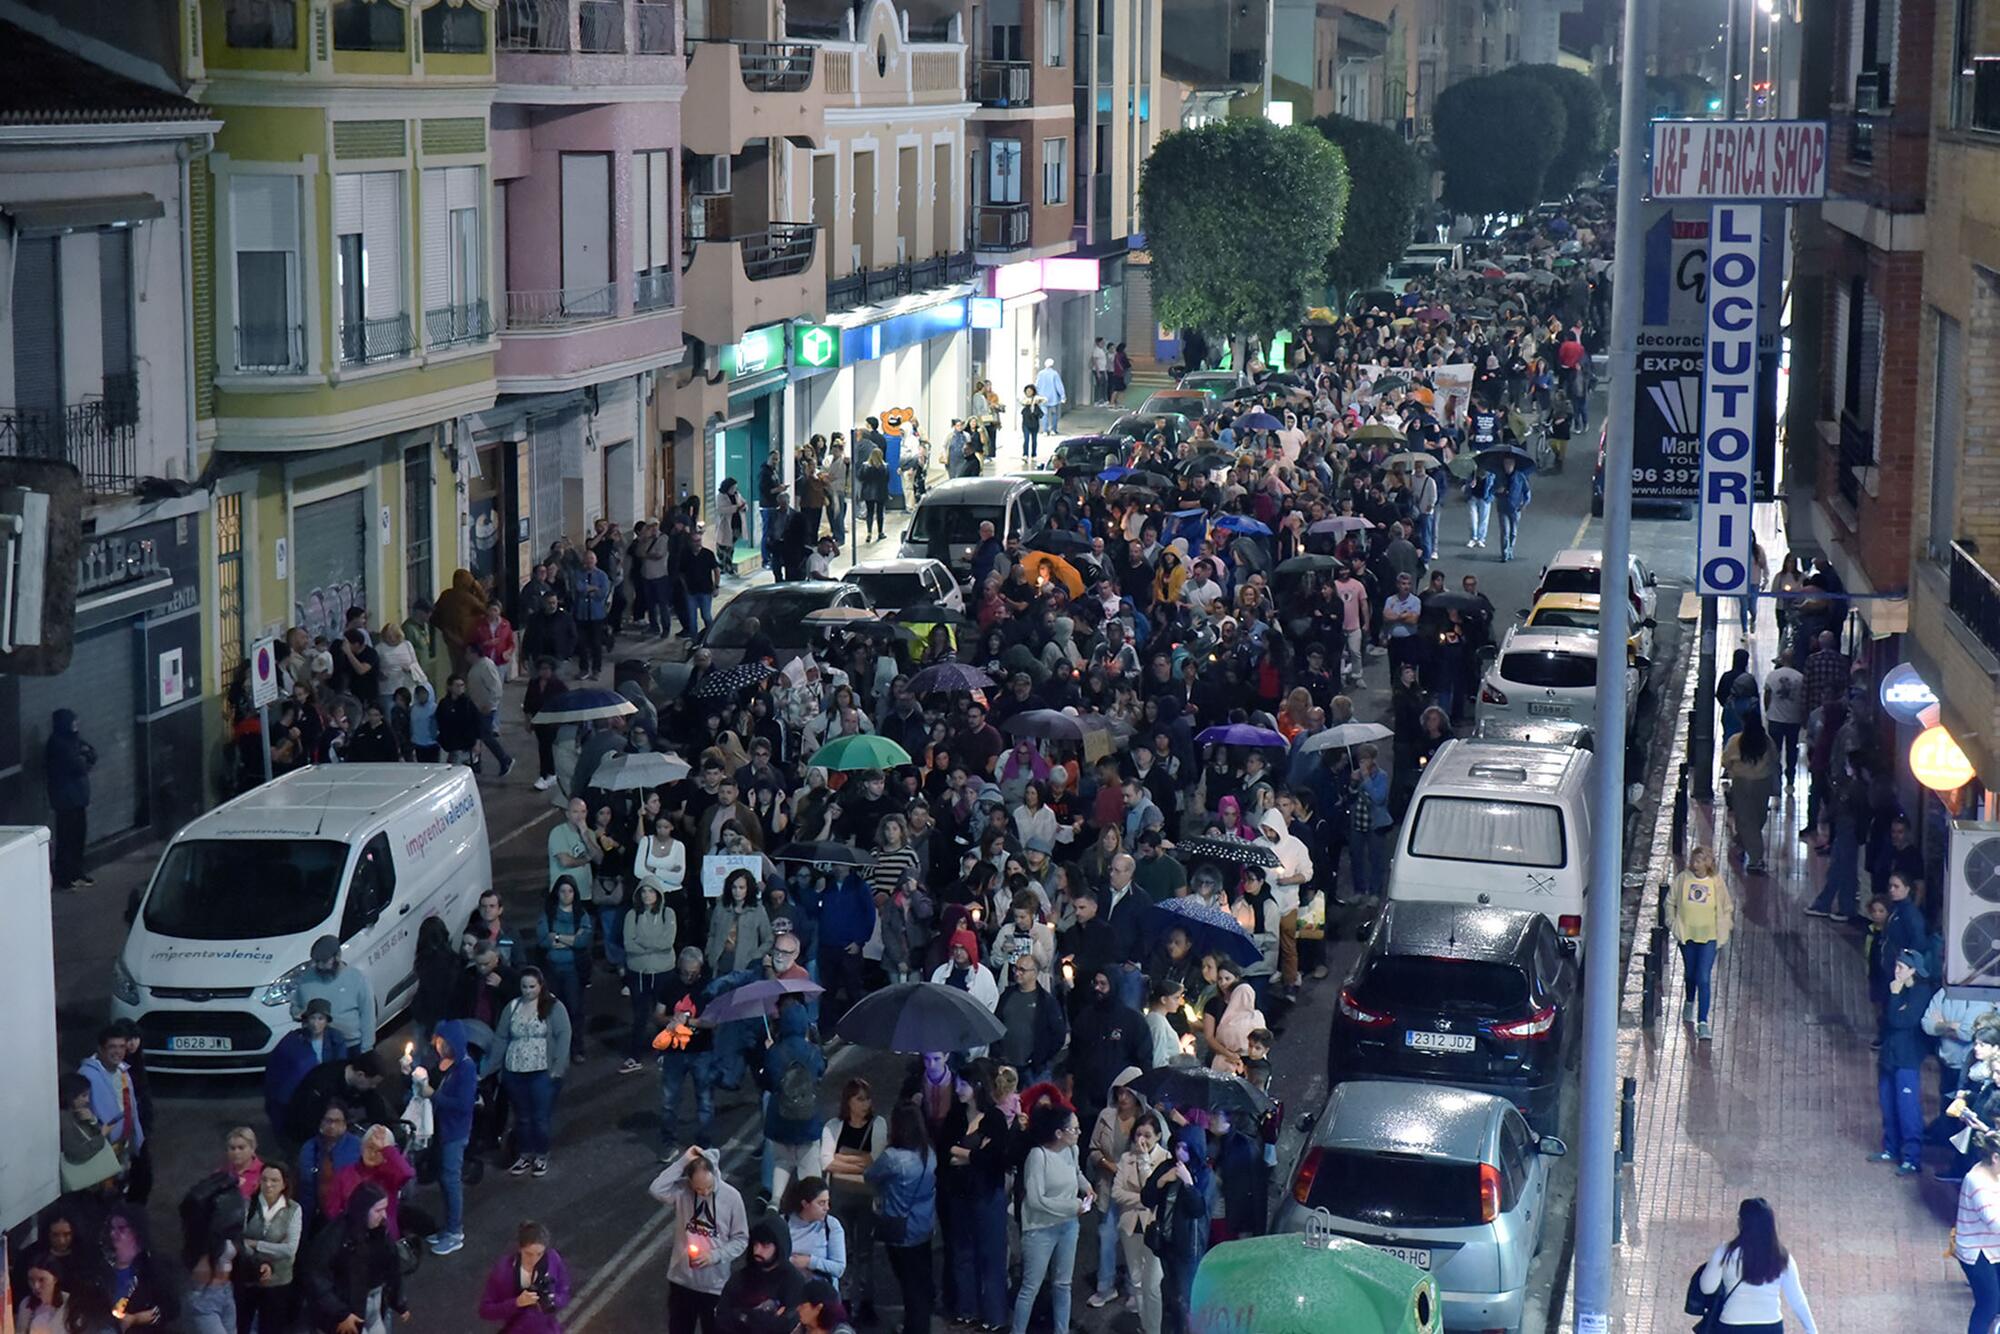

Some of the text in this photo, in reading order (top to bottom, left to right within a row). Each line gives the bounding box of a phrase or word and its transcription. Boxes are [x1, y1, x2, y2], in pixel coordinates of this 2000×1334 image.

[1654, 126, 1824, 195] J&F AFRICA SHOP
[1643, 358, 1704, 371] EXPOS
[1703, 209, 1756, 591] LOCUTORIO
[1662, 436, 1701, 454] Mart
[1667, 457, 1700, 465] TOL
[1414, 1032, 1473, 1049] 2312 JDZ
